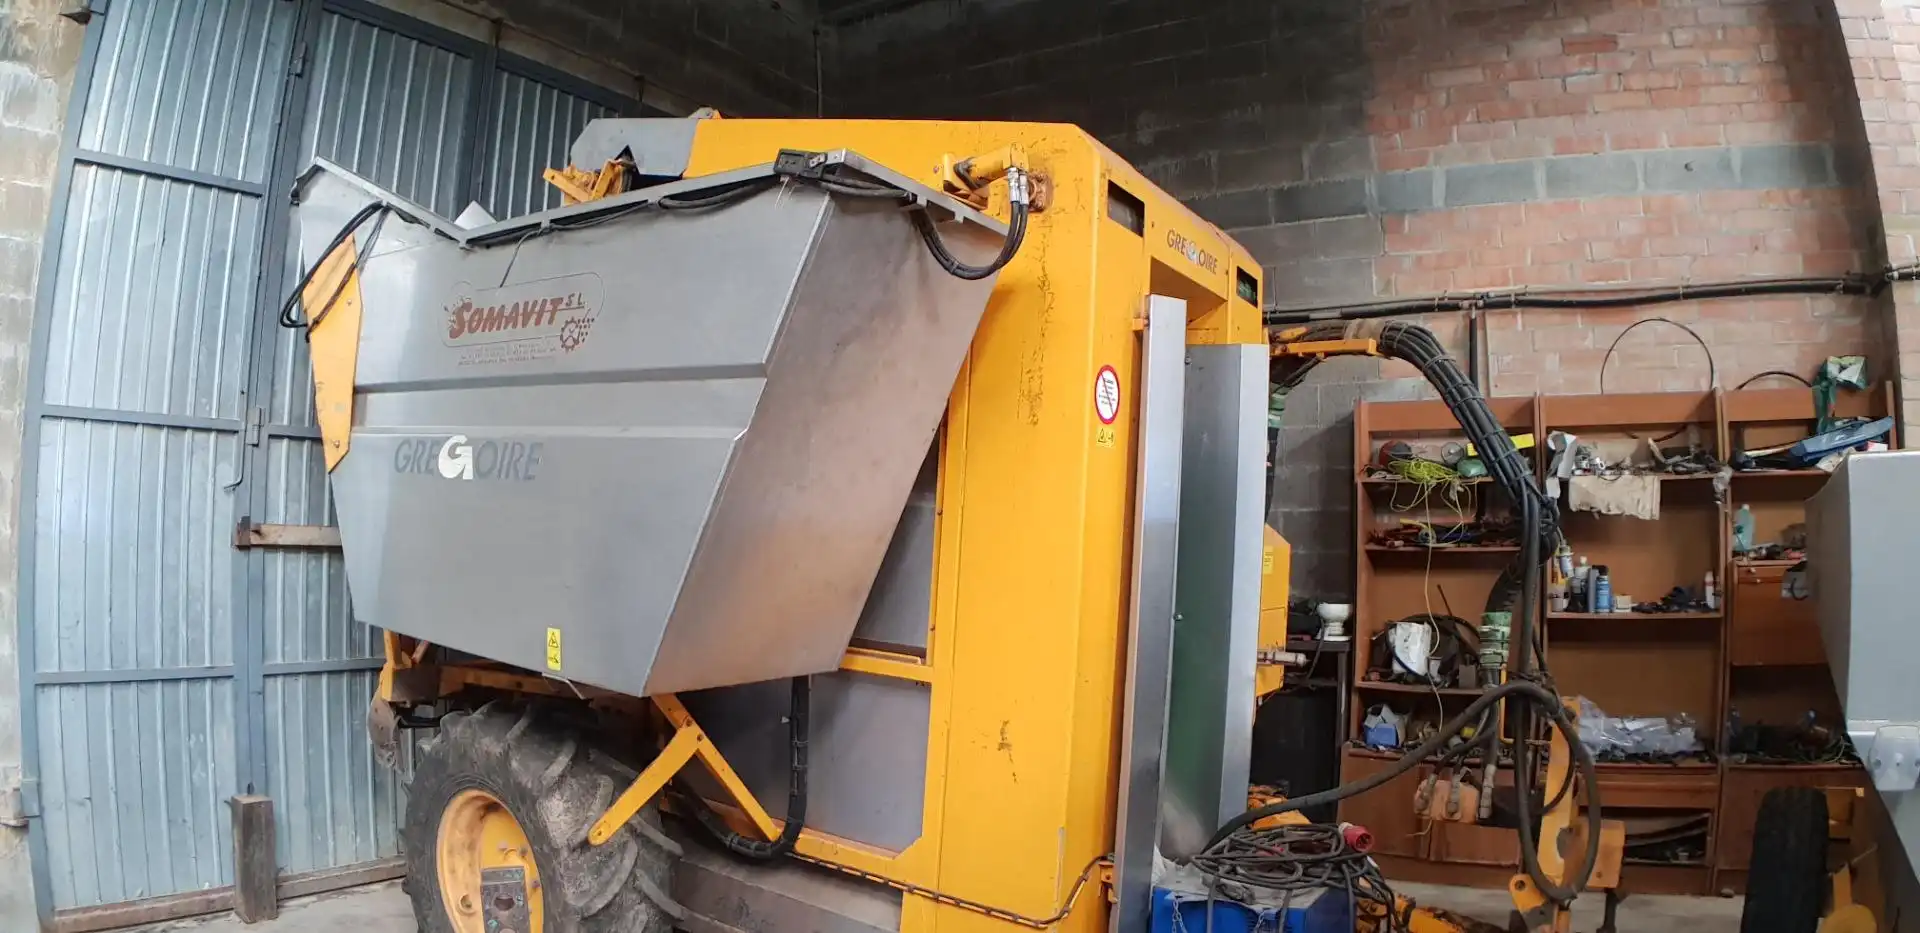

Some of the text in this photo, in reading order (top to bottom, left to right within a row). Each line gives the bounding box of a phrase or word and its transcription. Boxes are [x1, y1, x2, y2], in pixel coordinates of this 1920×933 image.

[1166, 228, 1219, 275] GREGOIRE
[448, 297, 564, 339] SOMAVIT
[394, 434, 544, 481] GREGOIRE
